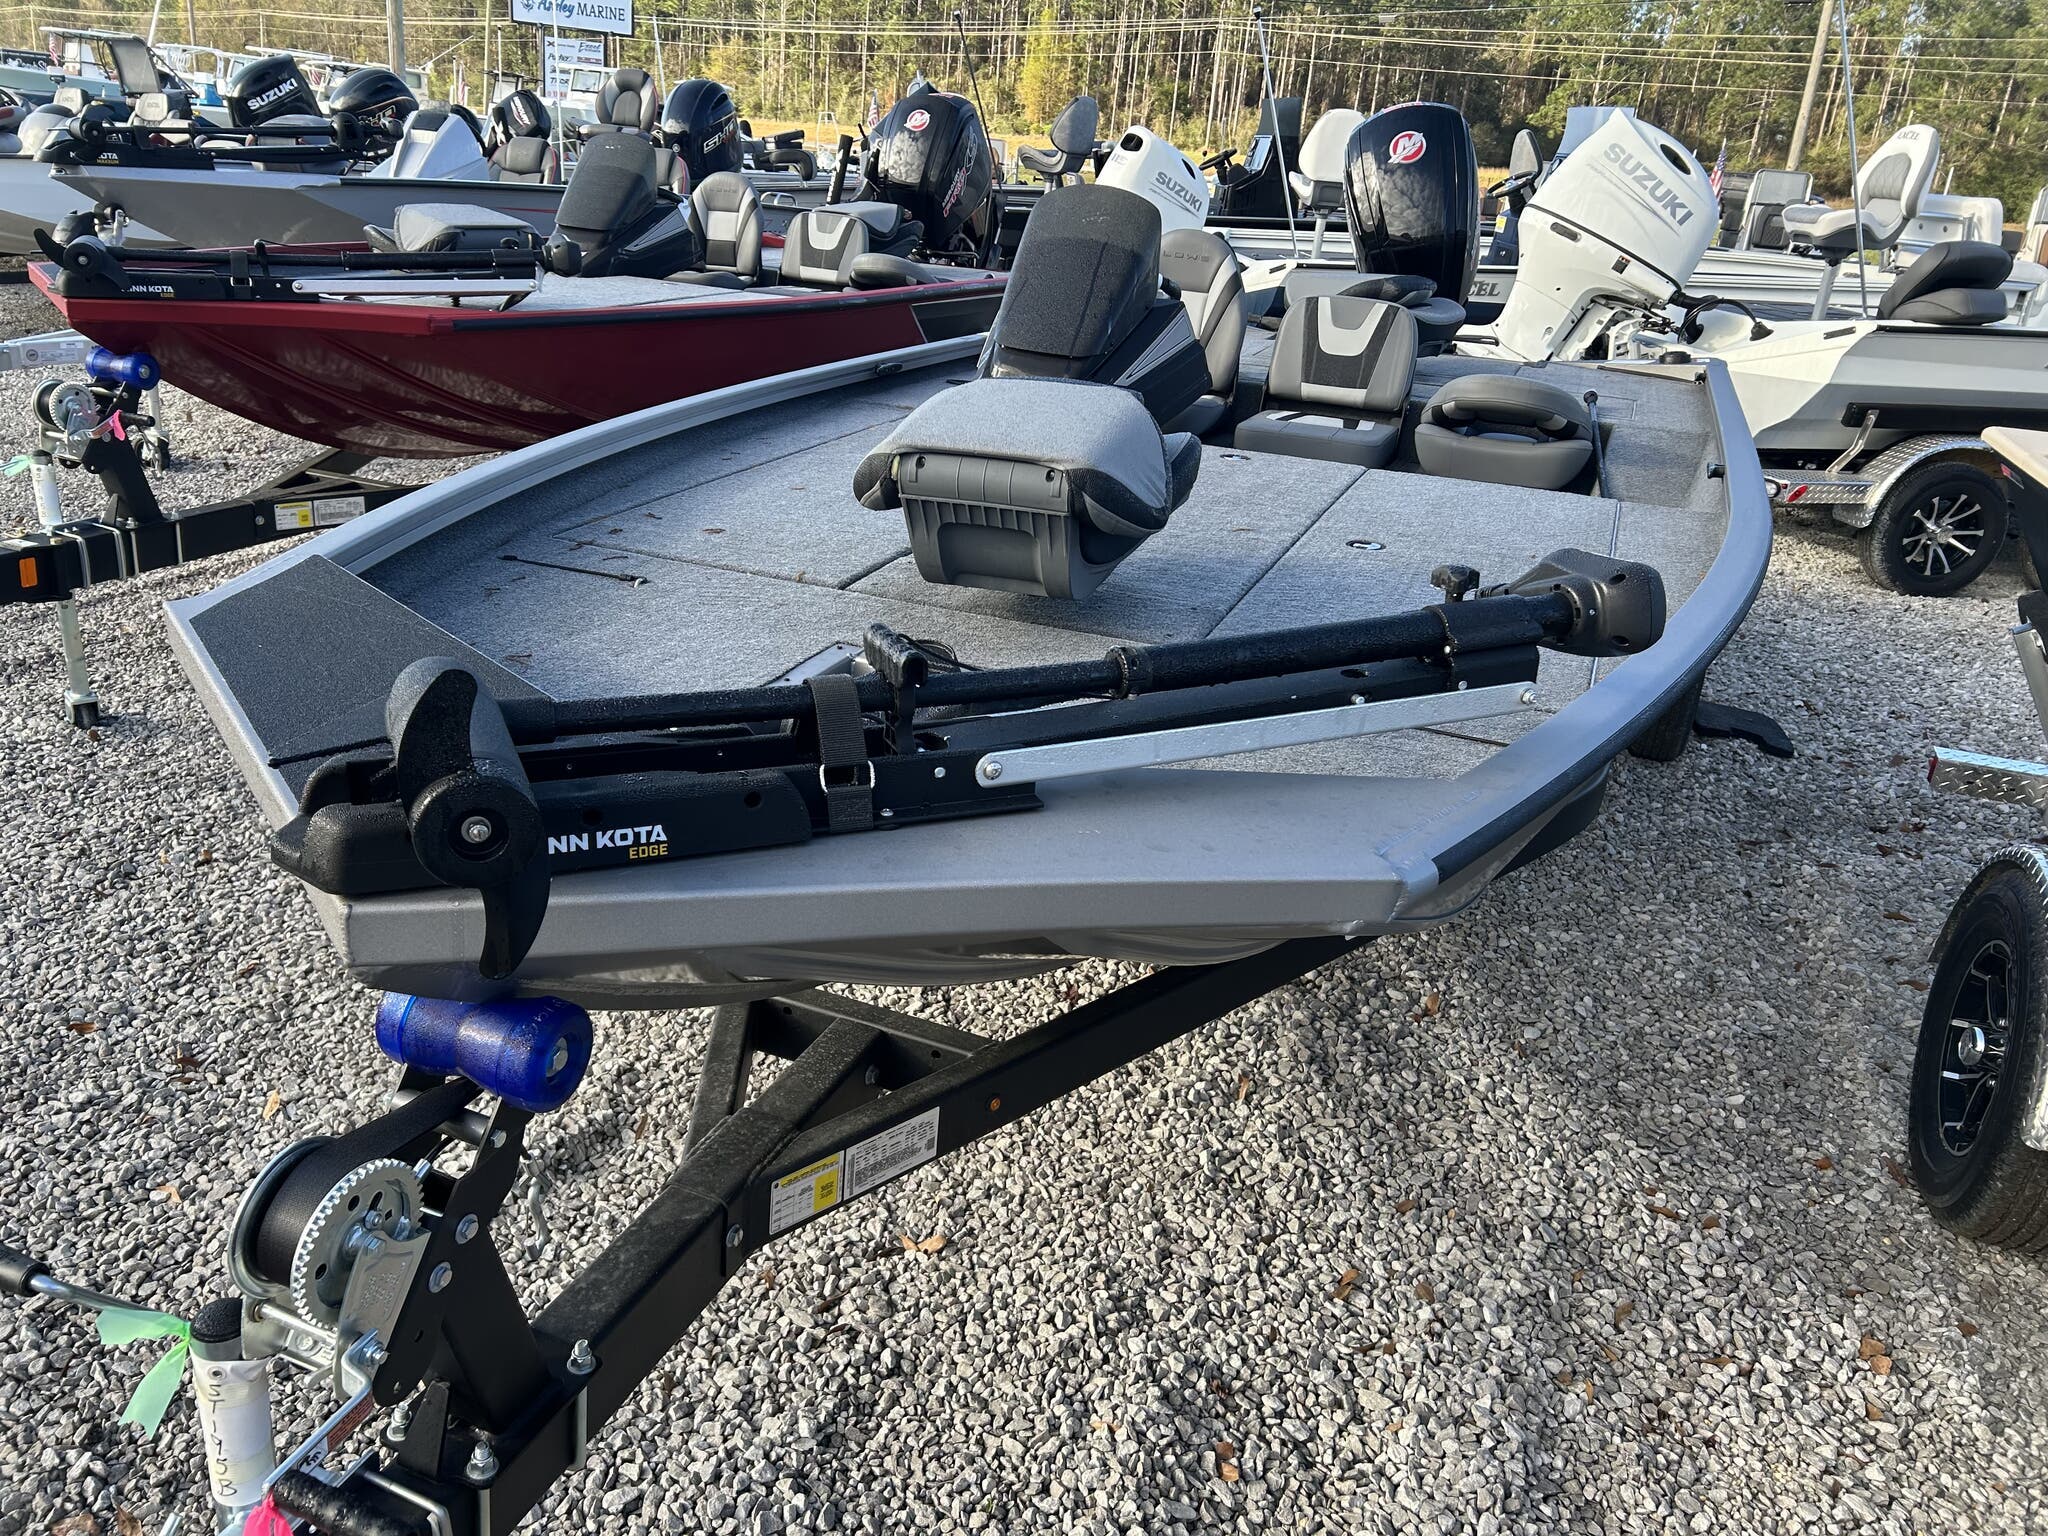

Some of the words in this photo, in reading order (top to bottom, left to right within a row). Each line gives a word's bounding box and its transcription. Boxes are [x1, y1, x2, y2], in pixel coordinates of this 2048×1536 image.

[577, 2, 625, 21] MARINE
[247, 78, 298, 110] SUZUKI
[1155, 171, 1203, 212] SUZUKI
[1604, 143, 1694, 226] SUZUKI
[148, 285, 174, 293] KOTA
[547, 833, 590, 855] NN
[596, 824, 668, 849] KOTA
[629, 843, 669, 860] EDGE
